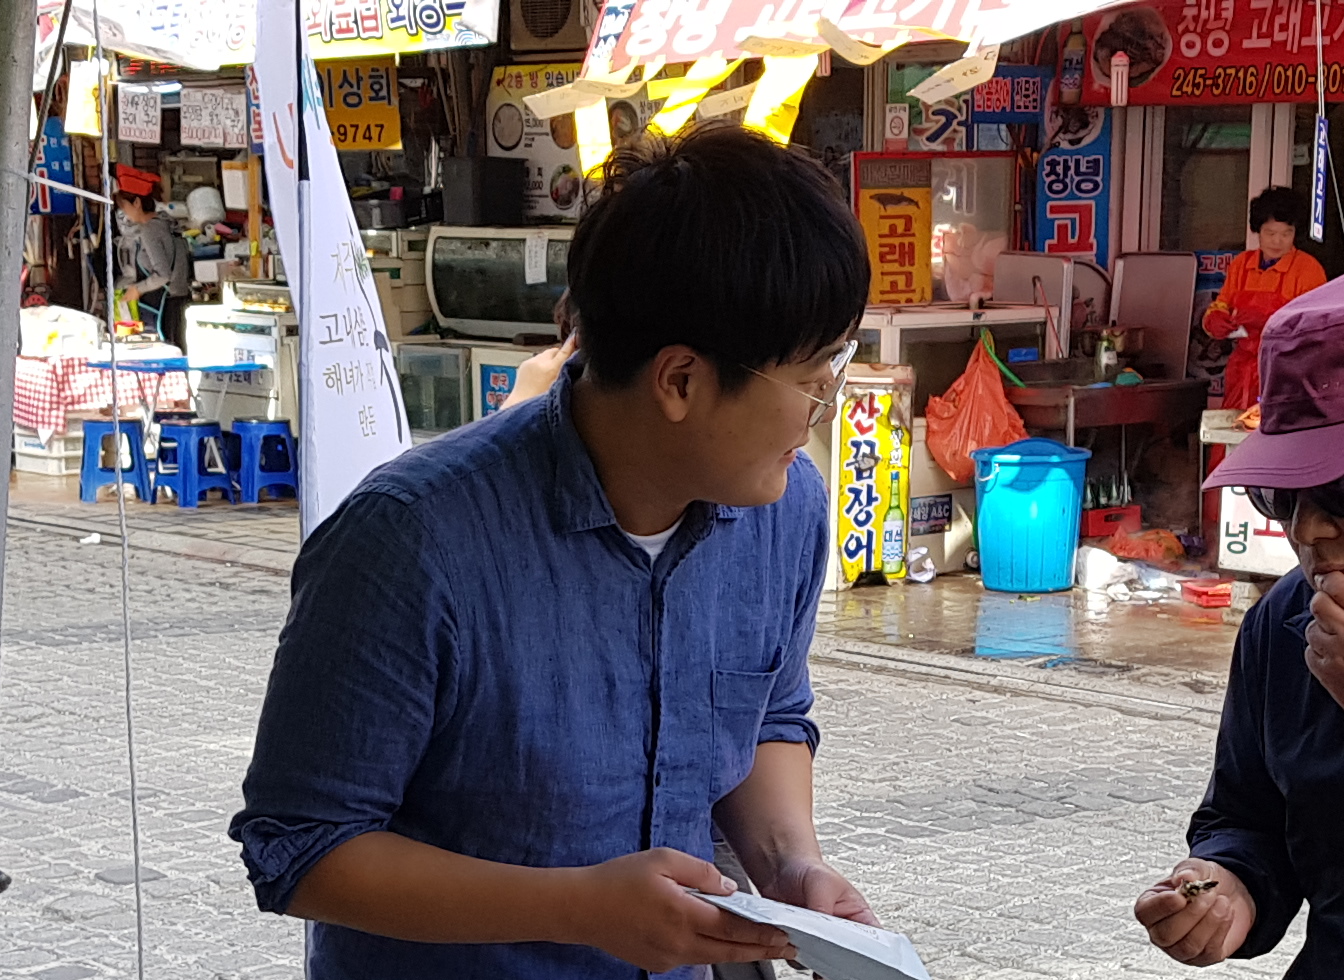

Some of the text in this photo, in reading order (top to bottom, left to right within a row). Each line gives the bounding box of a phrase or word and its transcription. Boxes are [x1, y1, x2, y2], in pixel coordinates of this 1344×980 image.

[1177, 0, 1234, 58] 창녕
[545, 69, 581, 88] 있습니
[1171, 66, 1258, 97] 245-3716
[1043, 156, 1104, 197] 창녕
[1046, 203, 1096, 256] 고
[877, 214, 916, 304] 고래고
[1199, 254, 1233, 274] 고래
